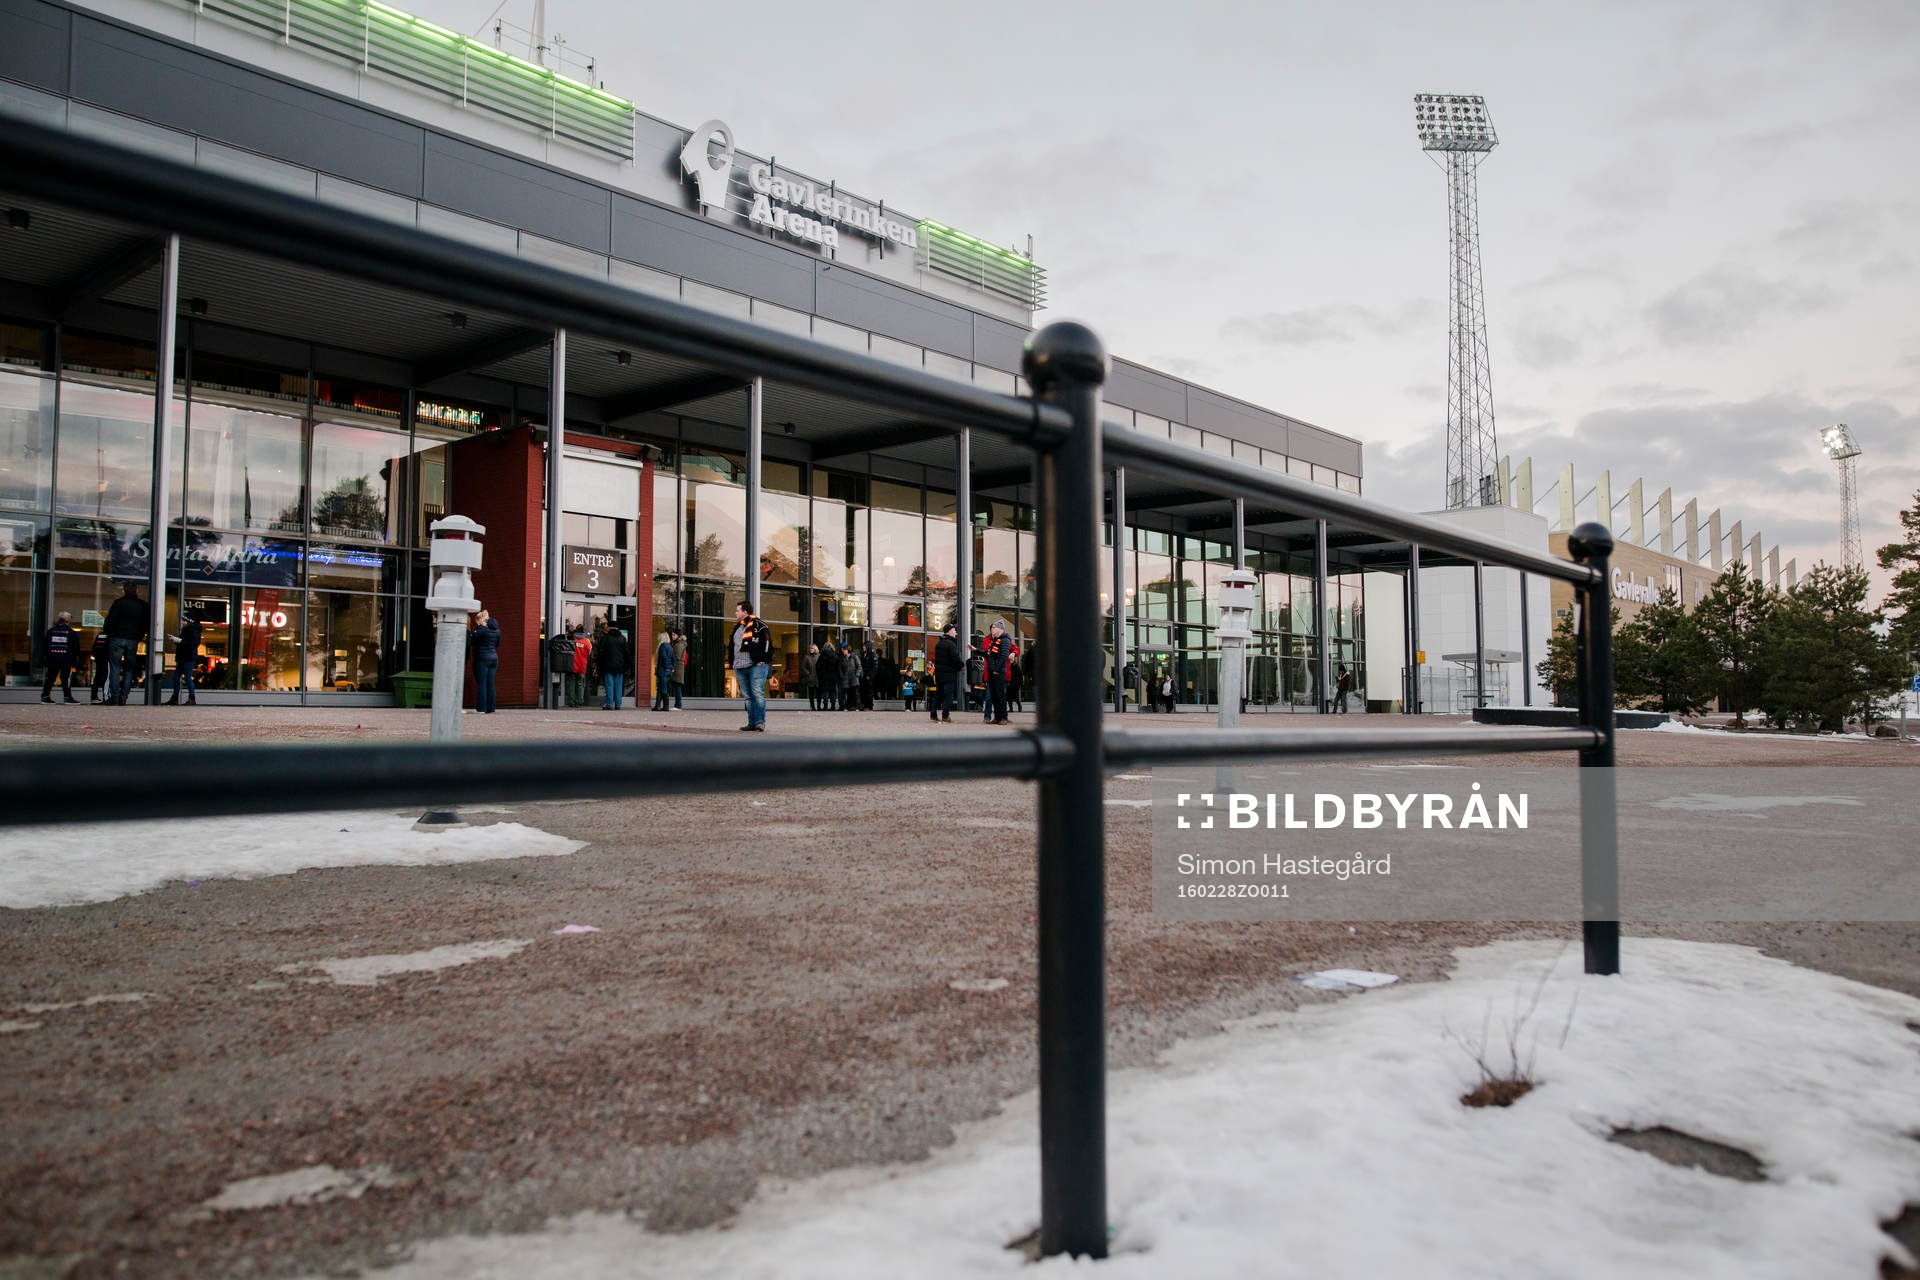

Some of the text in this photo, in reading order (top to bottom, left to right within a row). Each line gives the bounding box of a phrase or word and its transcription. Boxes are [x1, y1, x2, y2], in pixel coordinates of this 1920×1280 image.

[748, 163, 917, 249] Gavlerinken
[749, 193, 839, 249] Arena
[133, 538, 205, 562] Snta
[206, 543, 279, 565] Maria
[587, 569, 600, 589] 3
[848, 608, 859, 624] 4
[934, 615, 942, 630] 5
